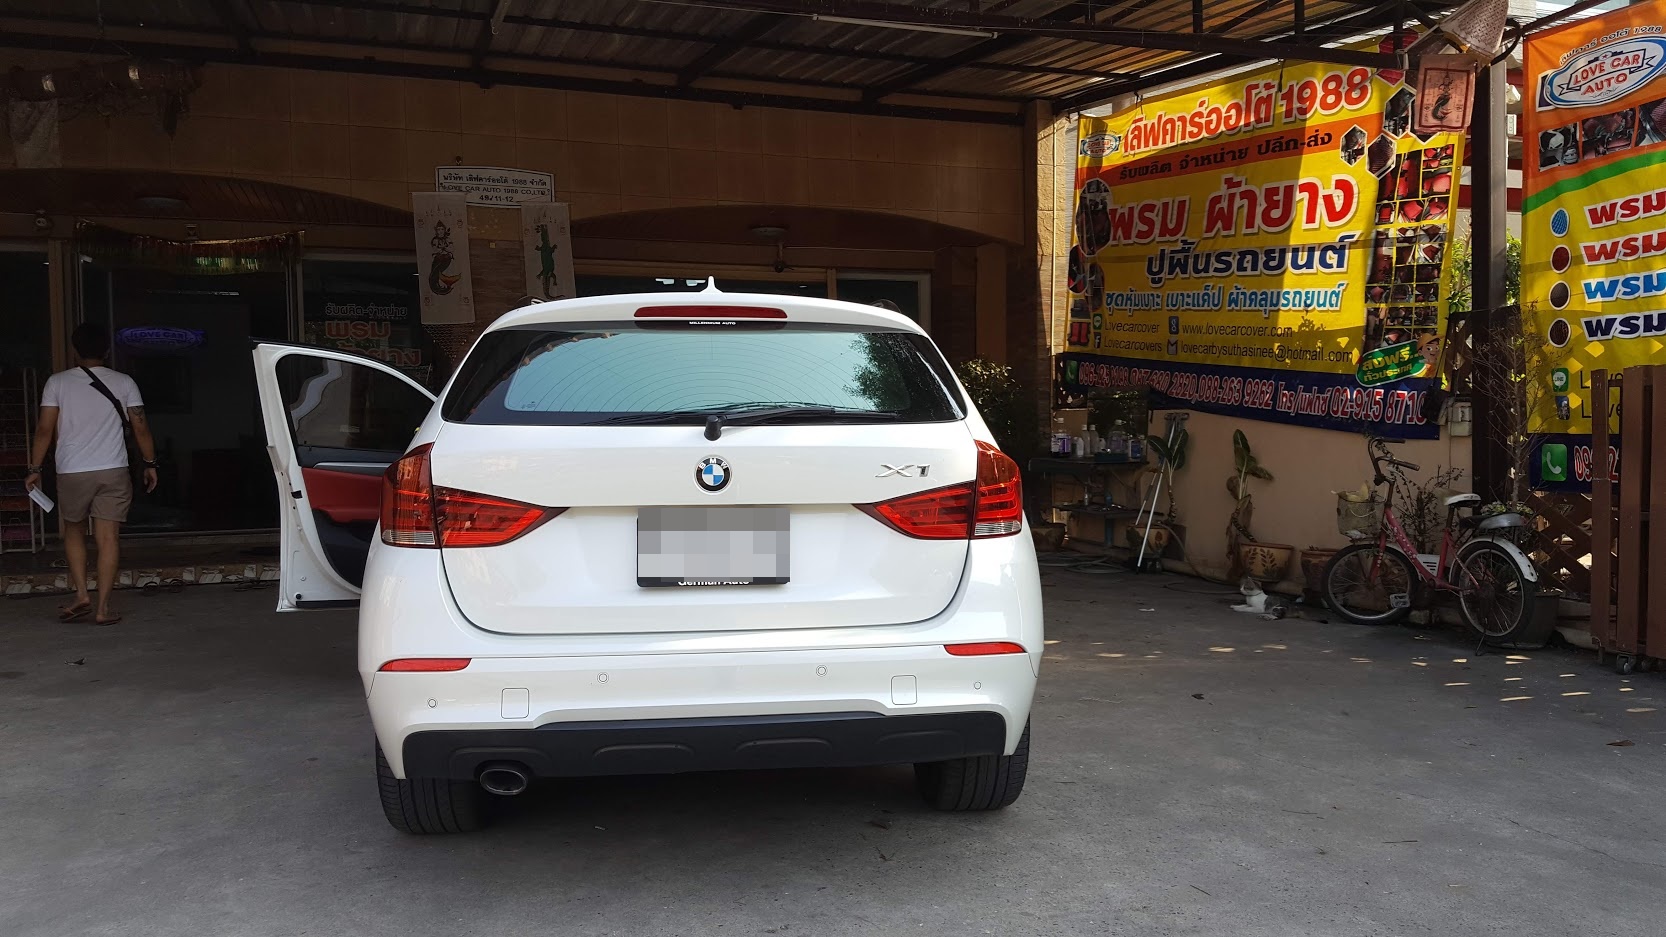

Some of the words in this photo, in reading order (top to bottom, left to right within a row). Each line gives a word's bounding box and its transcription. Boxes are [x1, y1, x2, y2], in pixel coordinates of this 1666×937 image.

[1633, 25, 1663, 35] 1988
[1573, 62, 1605, 84] LOVE
[1610, 54, 1641, 69] CAR
[1581, 73, 1628, 95] AUTO
[1122, 80, 1276, 154] เลิฟคาร์ออโต้
[1281, 67, 1372, 121] 1988
[1119, 158, 1172, 180] รับผลิต
[1179, 146, 1249, 171] จำหน่าย
[1108, 197, 1188, 244] พรม
[1205, 174, 1358, 238] ผ้ายาง
[1145, 232, 1362, 287] ปูพื้นรถยนต์
[1226, 281, 1348, 318] ผ้าคลุมรถยนต์
[131, 331, 161, 339] LOVE
[163, 331, 184, 339] CAR
[1181, 322, 1294, 339] www.lovecarcover.com
[1104, 336, 1163, 352] Lovecarcovers
[1243, 378, 1275, 410] 9262
[1330, 386, 1385, 423] 02-915
[697, 457, 729, 470] BMW
[875, 463, 931, 478] X1
